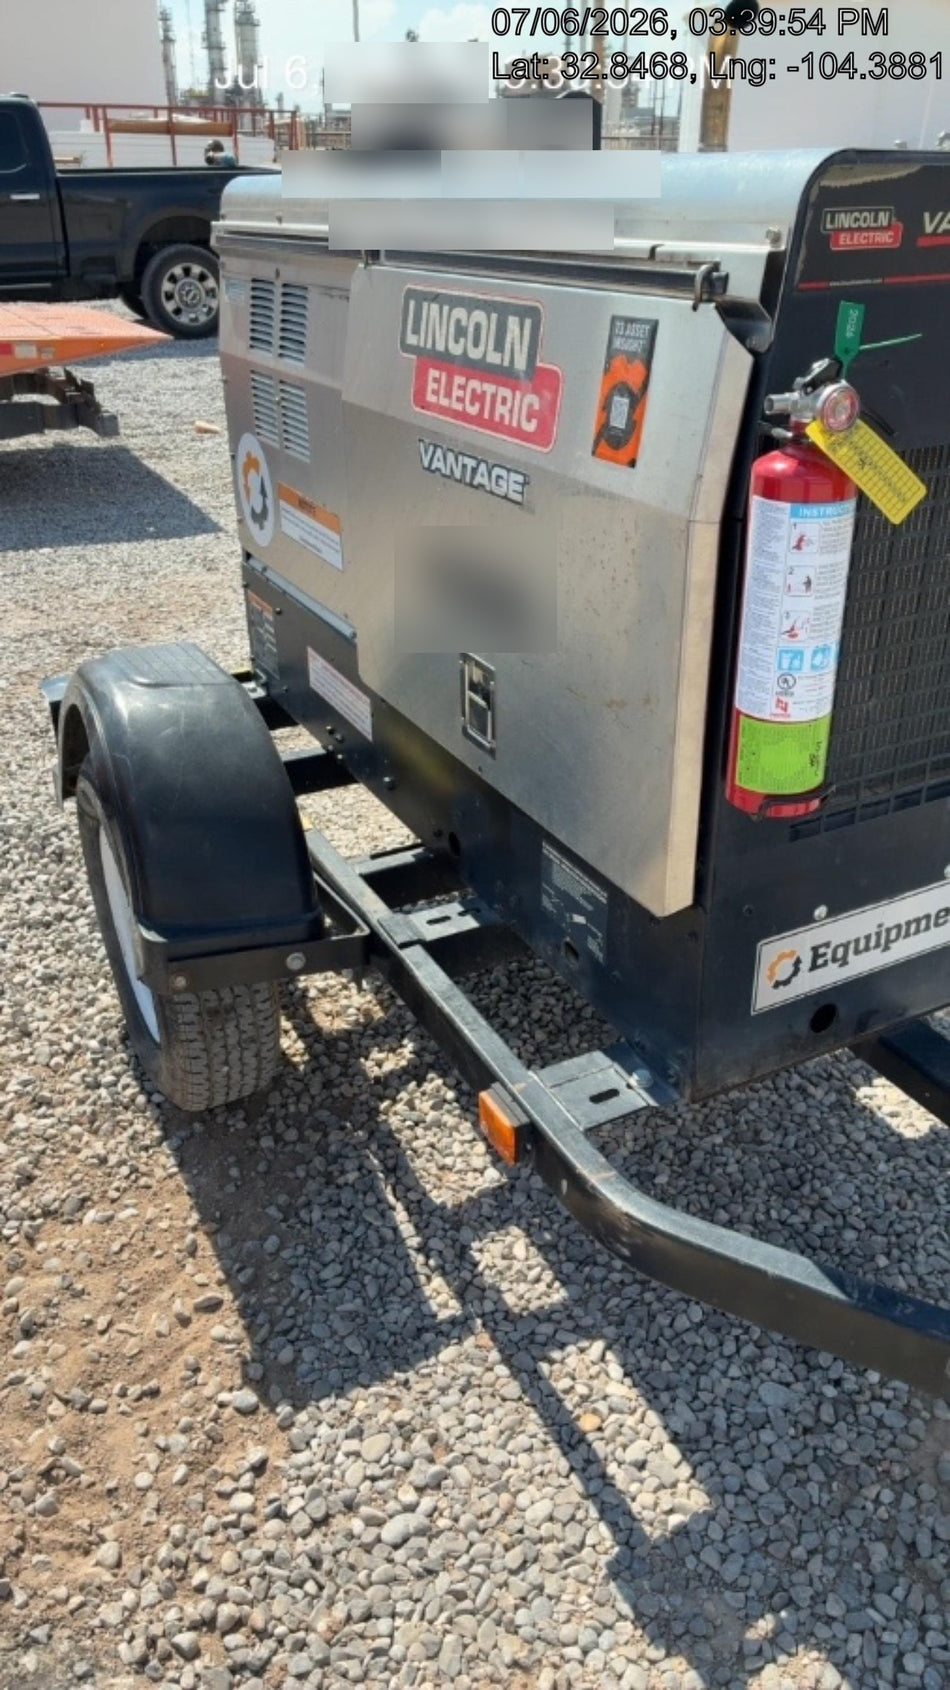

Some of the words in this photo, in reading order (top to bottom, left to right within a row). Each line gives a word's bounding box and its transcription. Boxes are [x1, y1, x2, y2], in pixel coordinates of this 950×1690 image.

[825, 211, 890, 230] LINCOLN
[838, 231, 894, 245] ELECTRIC
[404, 299, 532, 371] LINCOLN
[425, 367, 540, 432] ELECTRIC
[418, 439, 526, 505] VANTAGE
[808, 906, 950, 972] Equipme
